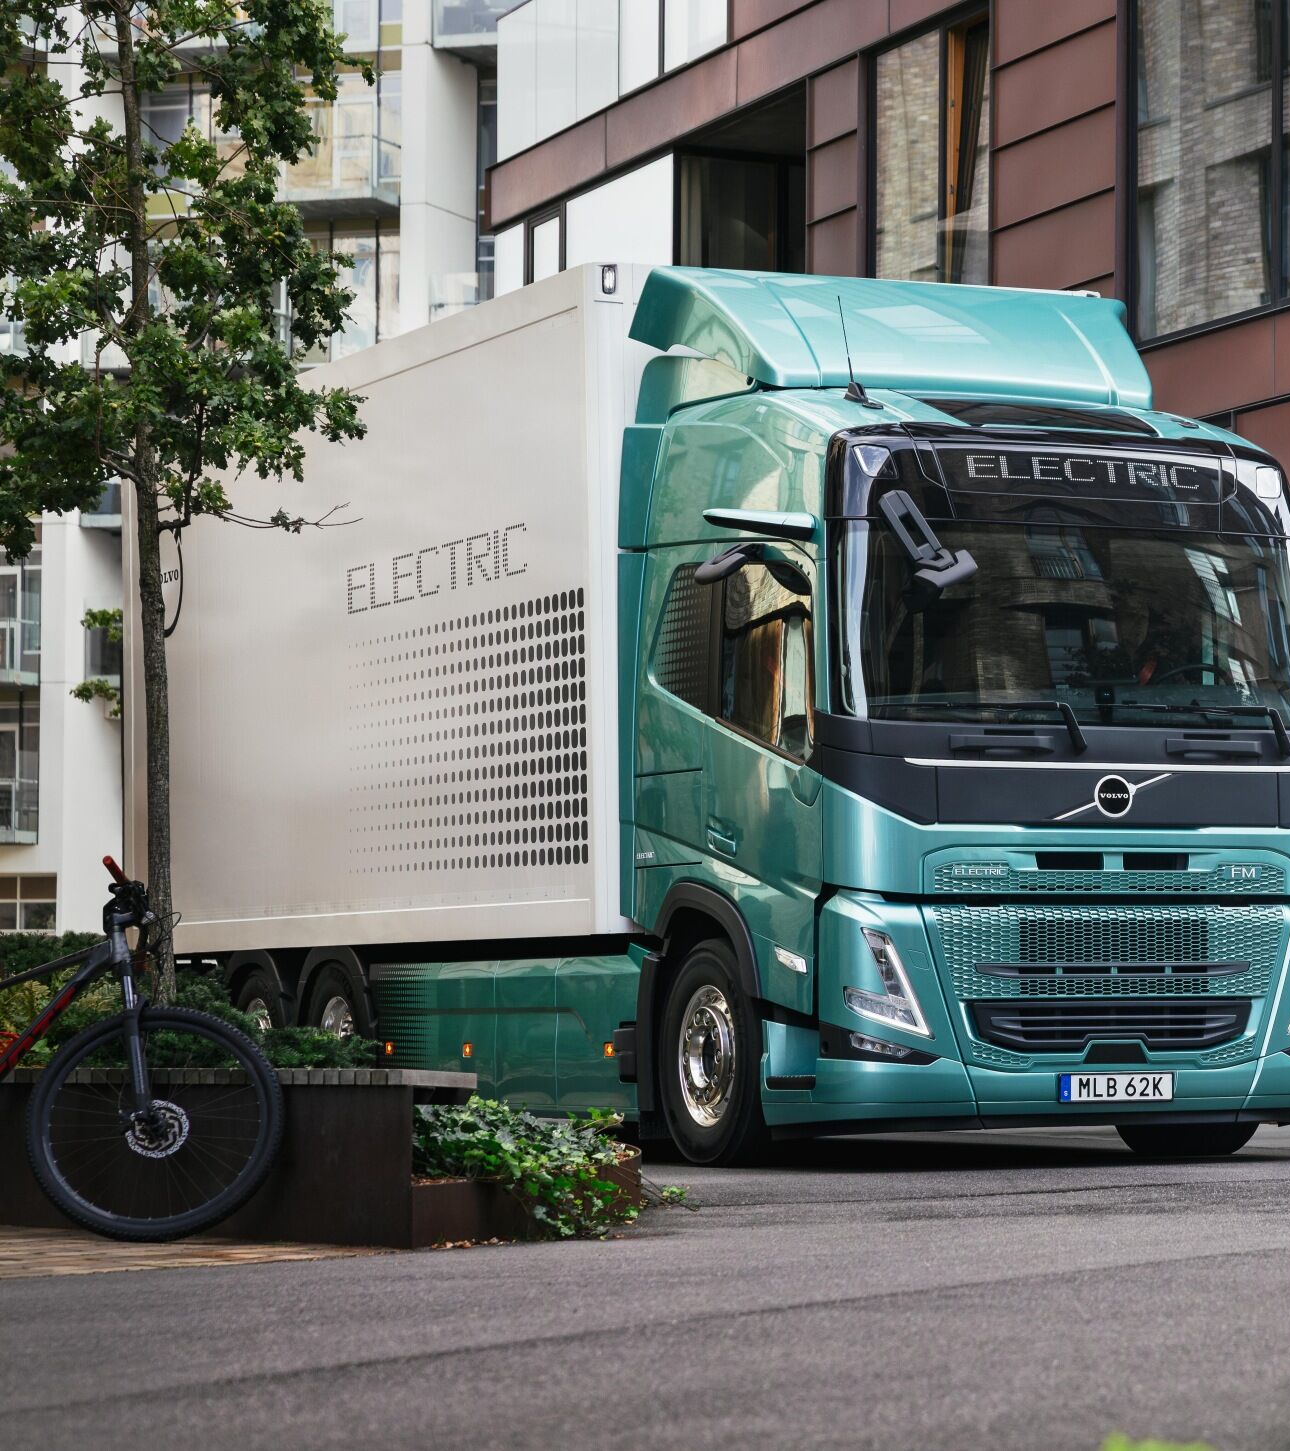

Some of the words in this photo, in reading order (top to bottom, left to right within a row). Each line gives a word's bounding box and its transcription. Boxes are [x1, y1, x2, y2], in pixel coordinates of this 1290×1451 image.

[966, 455, 1200, 490] ELECTRIC
[160, 569, 179, 584] OLVO
[347, 522, 528, 615] ELECTRIC
[954, 868, 1007, 876] ELECTRIC
[1231, 867, 1256, 878] FM
[1078, 1077, 1117, 1098] MLB
[1125, 1076, 1164, 1097] 62K
